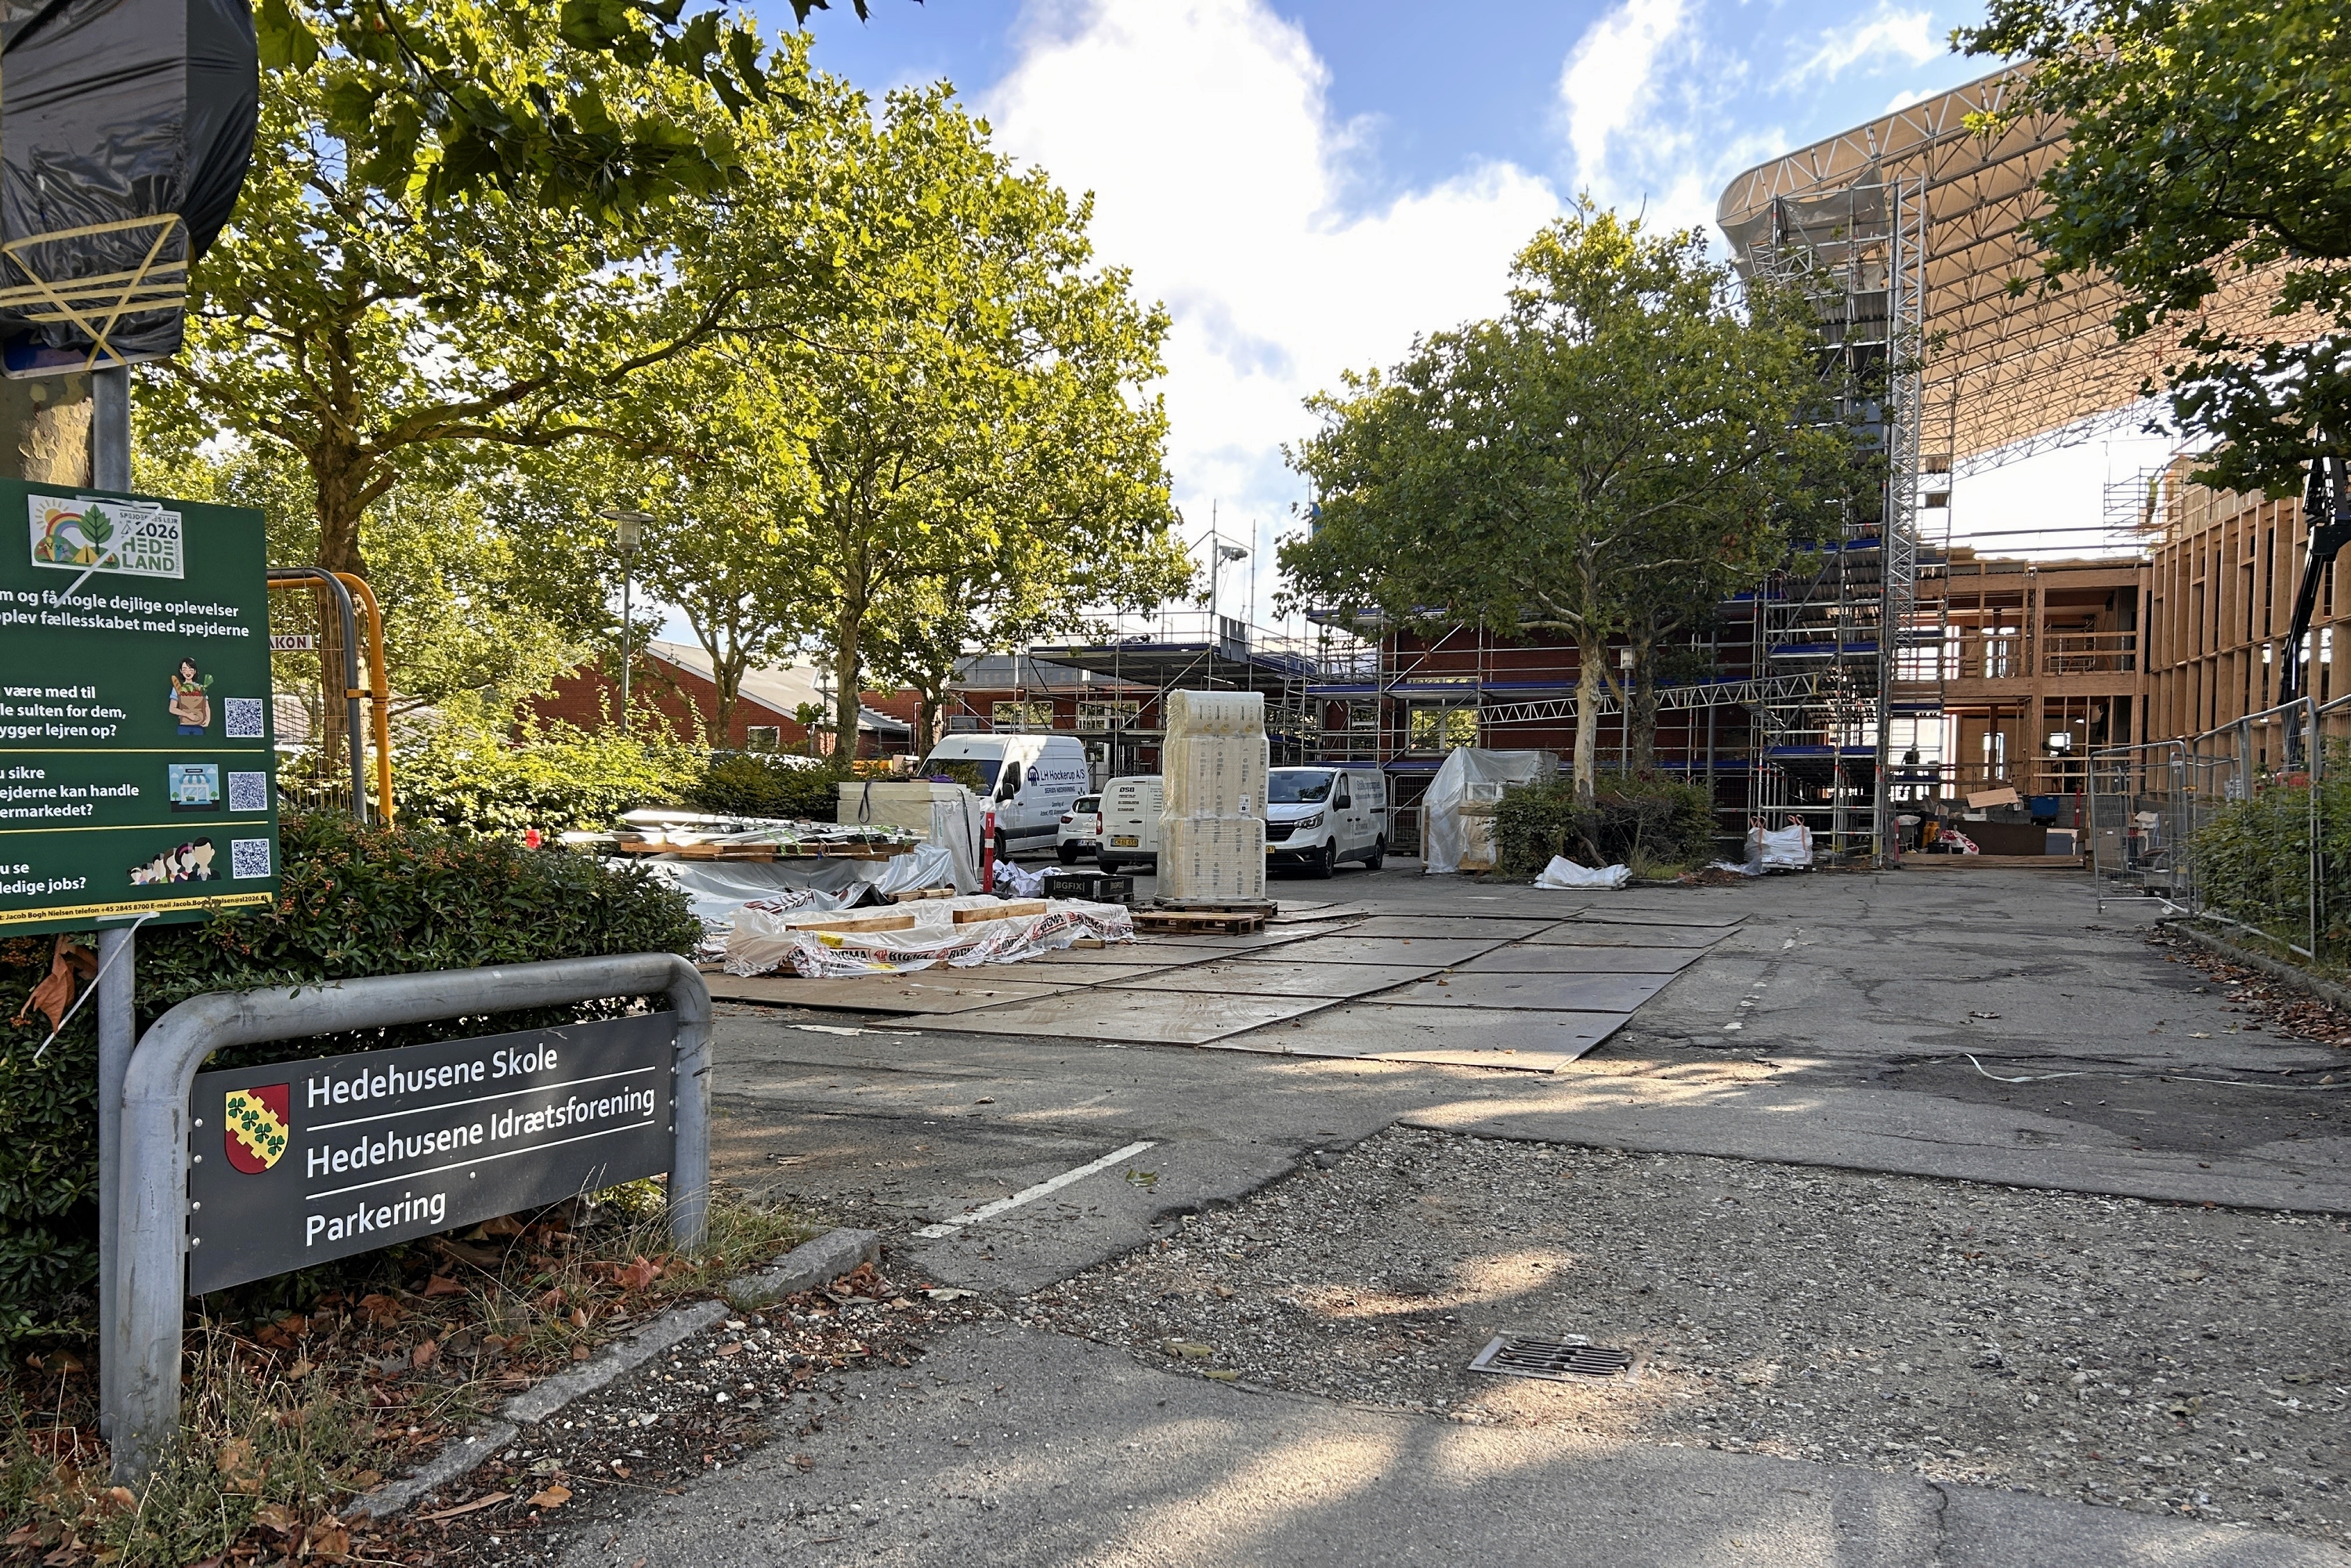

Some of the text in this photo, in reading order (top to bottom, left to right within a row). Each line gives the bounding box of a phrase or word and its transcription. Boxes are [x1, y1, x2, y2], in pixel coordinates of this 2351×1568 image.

[135, 522, 179, 539] 2026
[121, 536, 174, 556] HEDE
[121, 553, 175, 571] LAND
[17, 591, 38, 606] og
[42, 589, 57, 604] få
[62, 593, 107, 610] nogle
[110, 596, 162, 614] dejlige
[165, 600, 239, 617] oplevelser
[0, 609, 249, 637] plev fællesskabet med spejderne
[4, 686, 96, 699] være med til
[17, 703, 63, 717] sulten
[66, 704, 88, 717] for
[90, 705, 126, 719] dem,
[45, 723, 88, 739] lejren
[91, 724, 117, 739] op?
[8, 766, 45, 779] sikre
[1040, 770, 1049, 780] LH
[1076, 769, 1085, 780] A/S
[60, 784, 87, 798] kan
[90, 784, 139, 797] handle
[13, 863, 30, 874] se
[47, 877, 86, 894] jobs?
[1056, 881, 1082, 890] BGFIX
[27, 911, 46, 919] Bogh
[74, 907, 100, 915] telefon
[307, 1043, 558, 1108] Hedehusene Skole
[306, 1086, 655, 1178] Hedehusene Idrætsforening
[306, 1192, 446, 1246] Parkering
